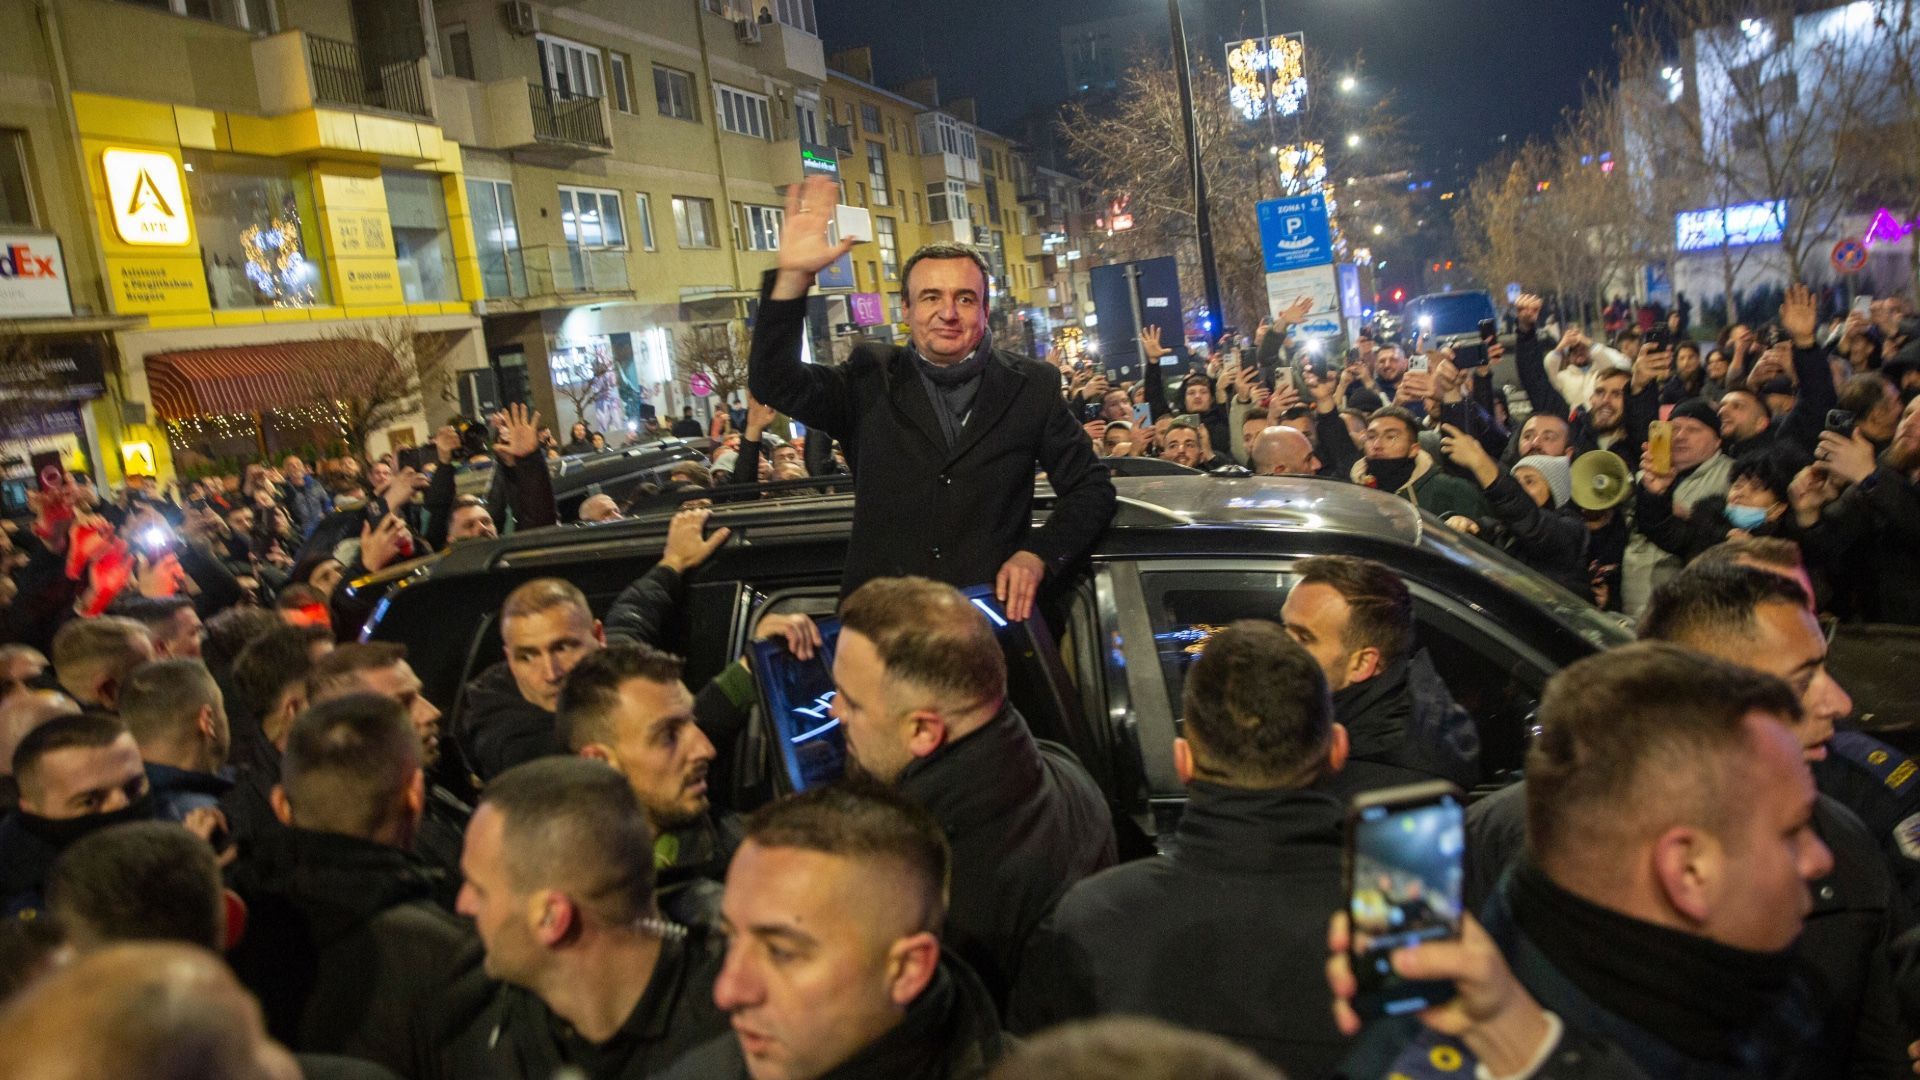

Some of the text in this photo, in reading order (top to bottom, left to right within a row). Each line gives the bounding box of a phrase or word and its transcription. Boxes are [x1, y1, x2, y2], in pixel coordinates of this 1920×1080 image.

[1277, 203, 1300, 214] ZONA
[1301, 202, 1306, 211] 1
[141, 222, 168, 232] APR
[1286, 217, 1302, 235] P
